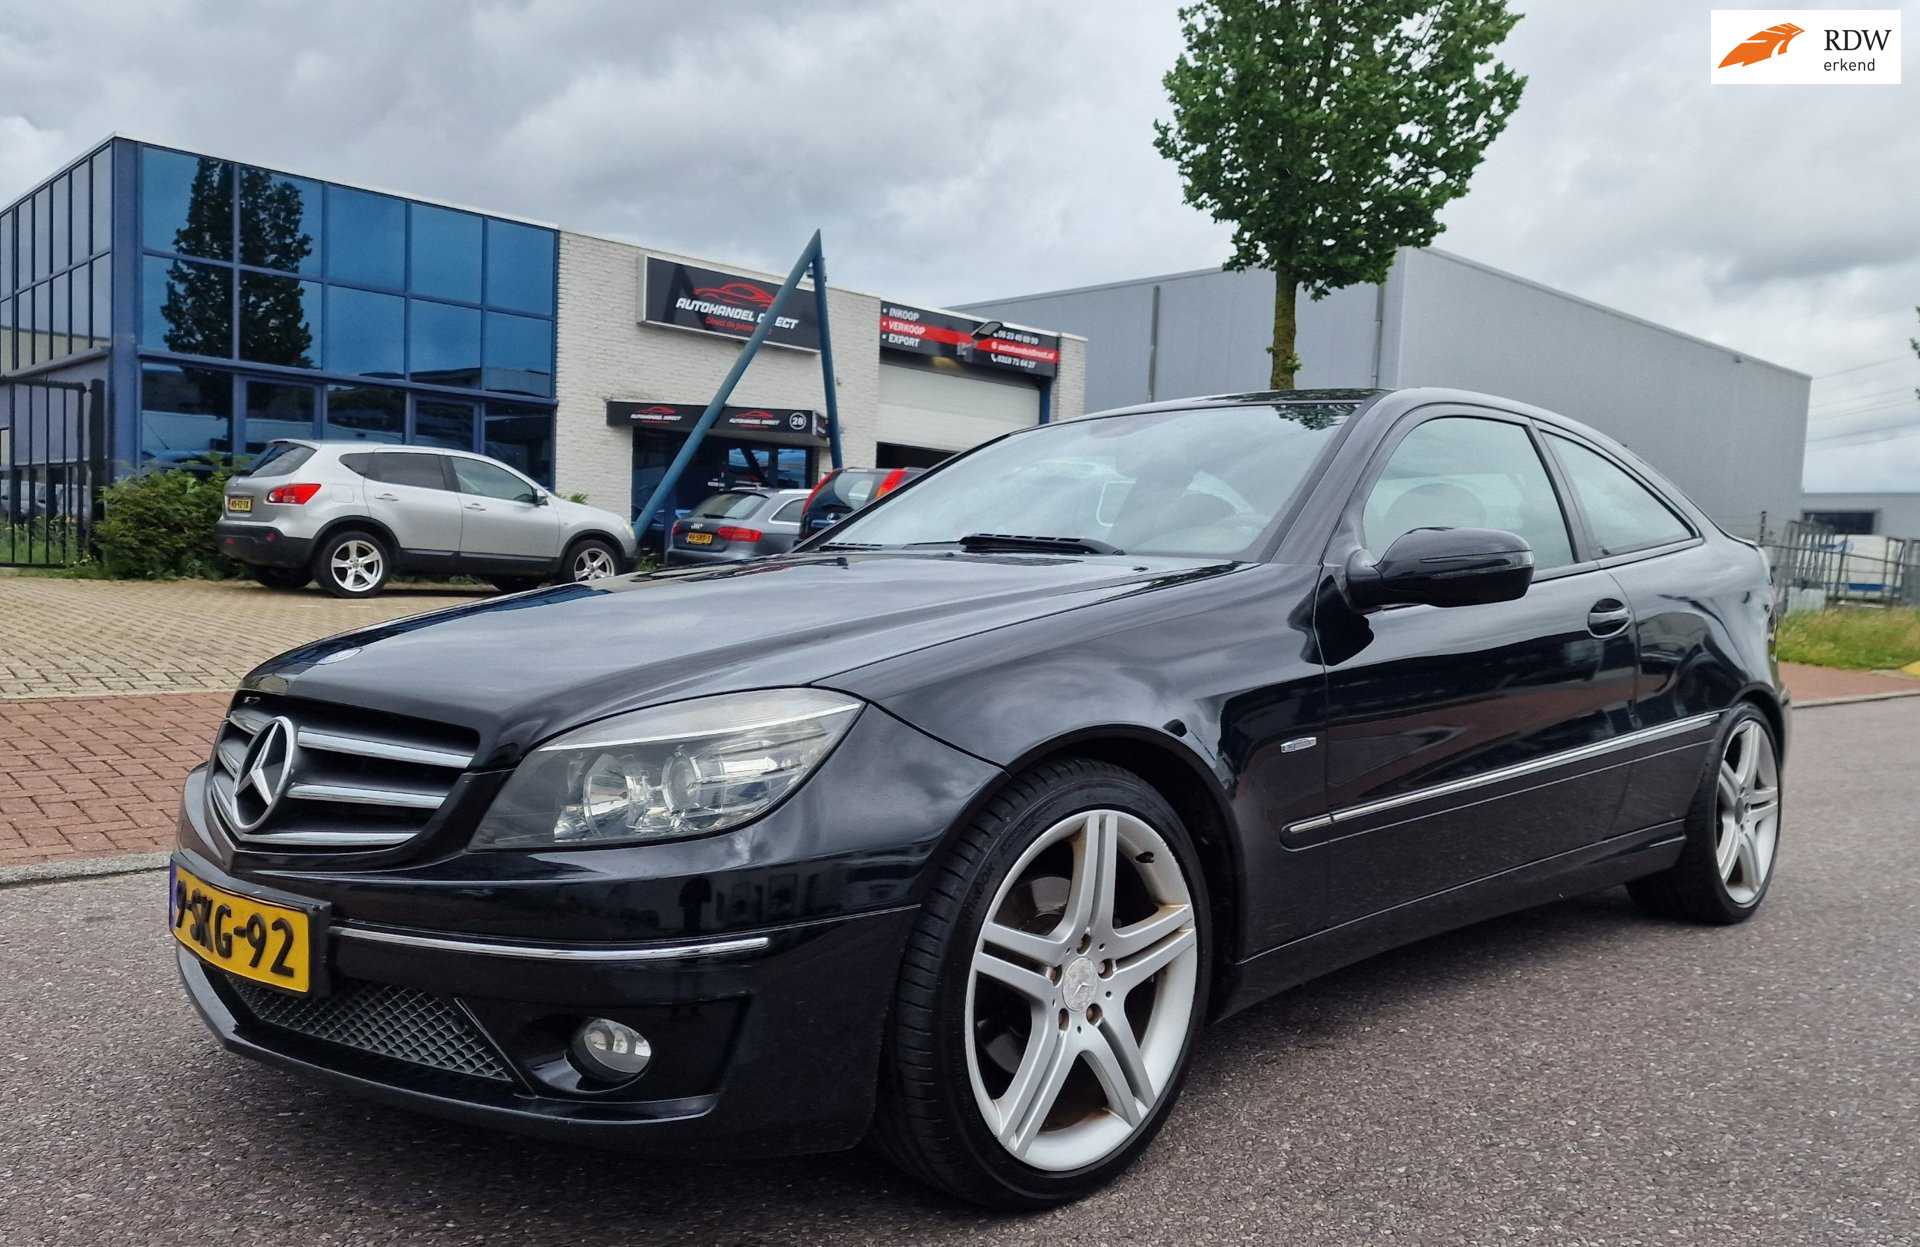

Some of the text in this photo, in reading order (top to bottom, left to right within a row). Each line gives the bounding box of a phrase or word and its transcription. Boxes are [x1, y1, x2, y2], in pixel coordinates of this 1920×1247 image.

[676, 297, 799, 329] AUTOHANDEL DECT
[889, 307, 919, 321] INKOOP
[889, 321, 925, 335] VERKOOP
[888, 333, 920, 347] EXPORT
[176, 880, 294, 977] 9-SXG-92
